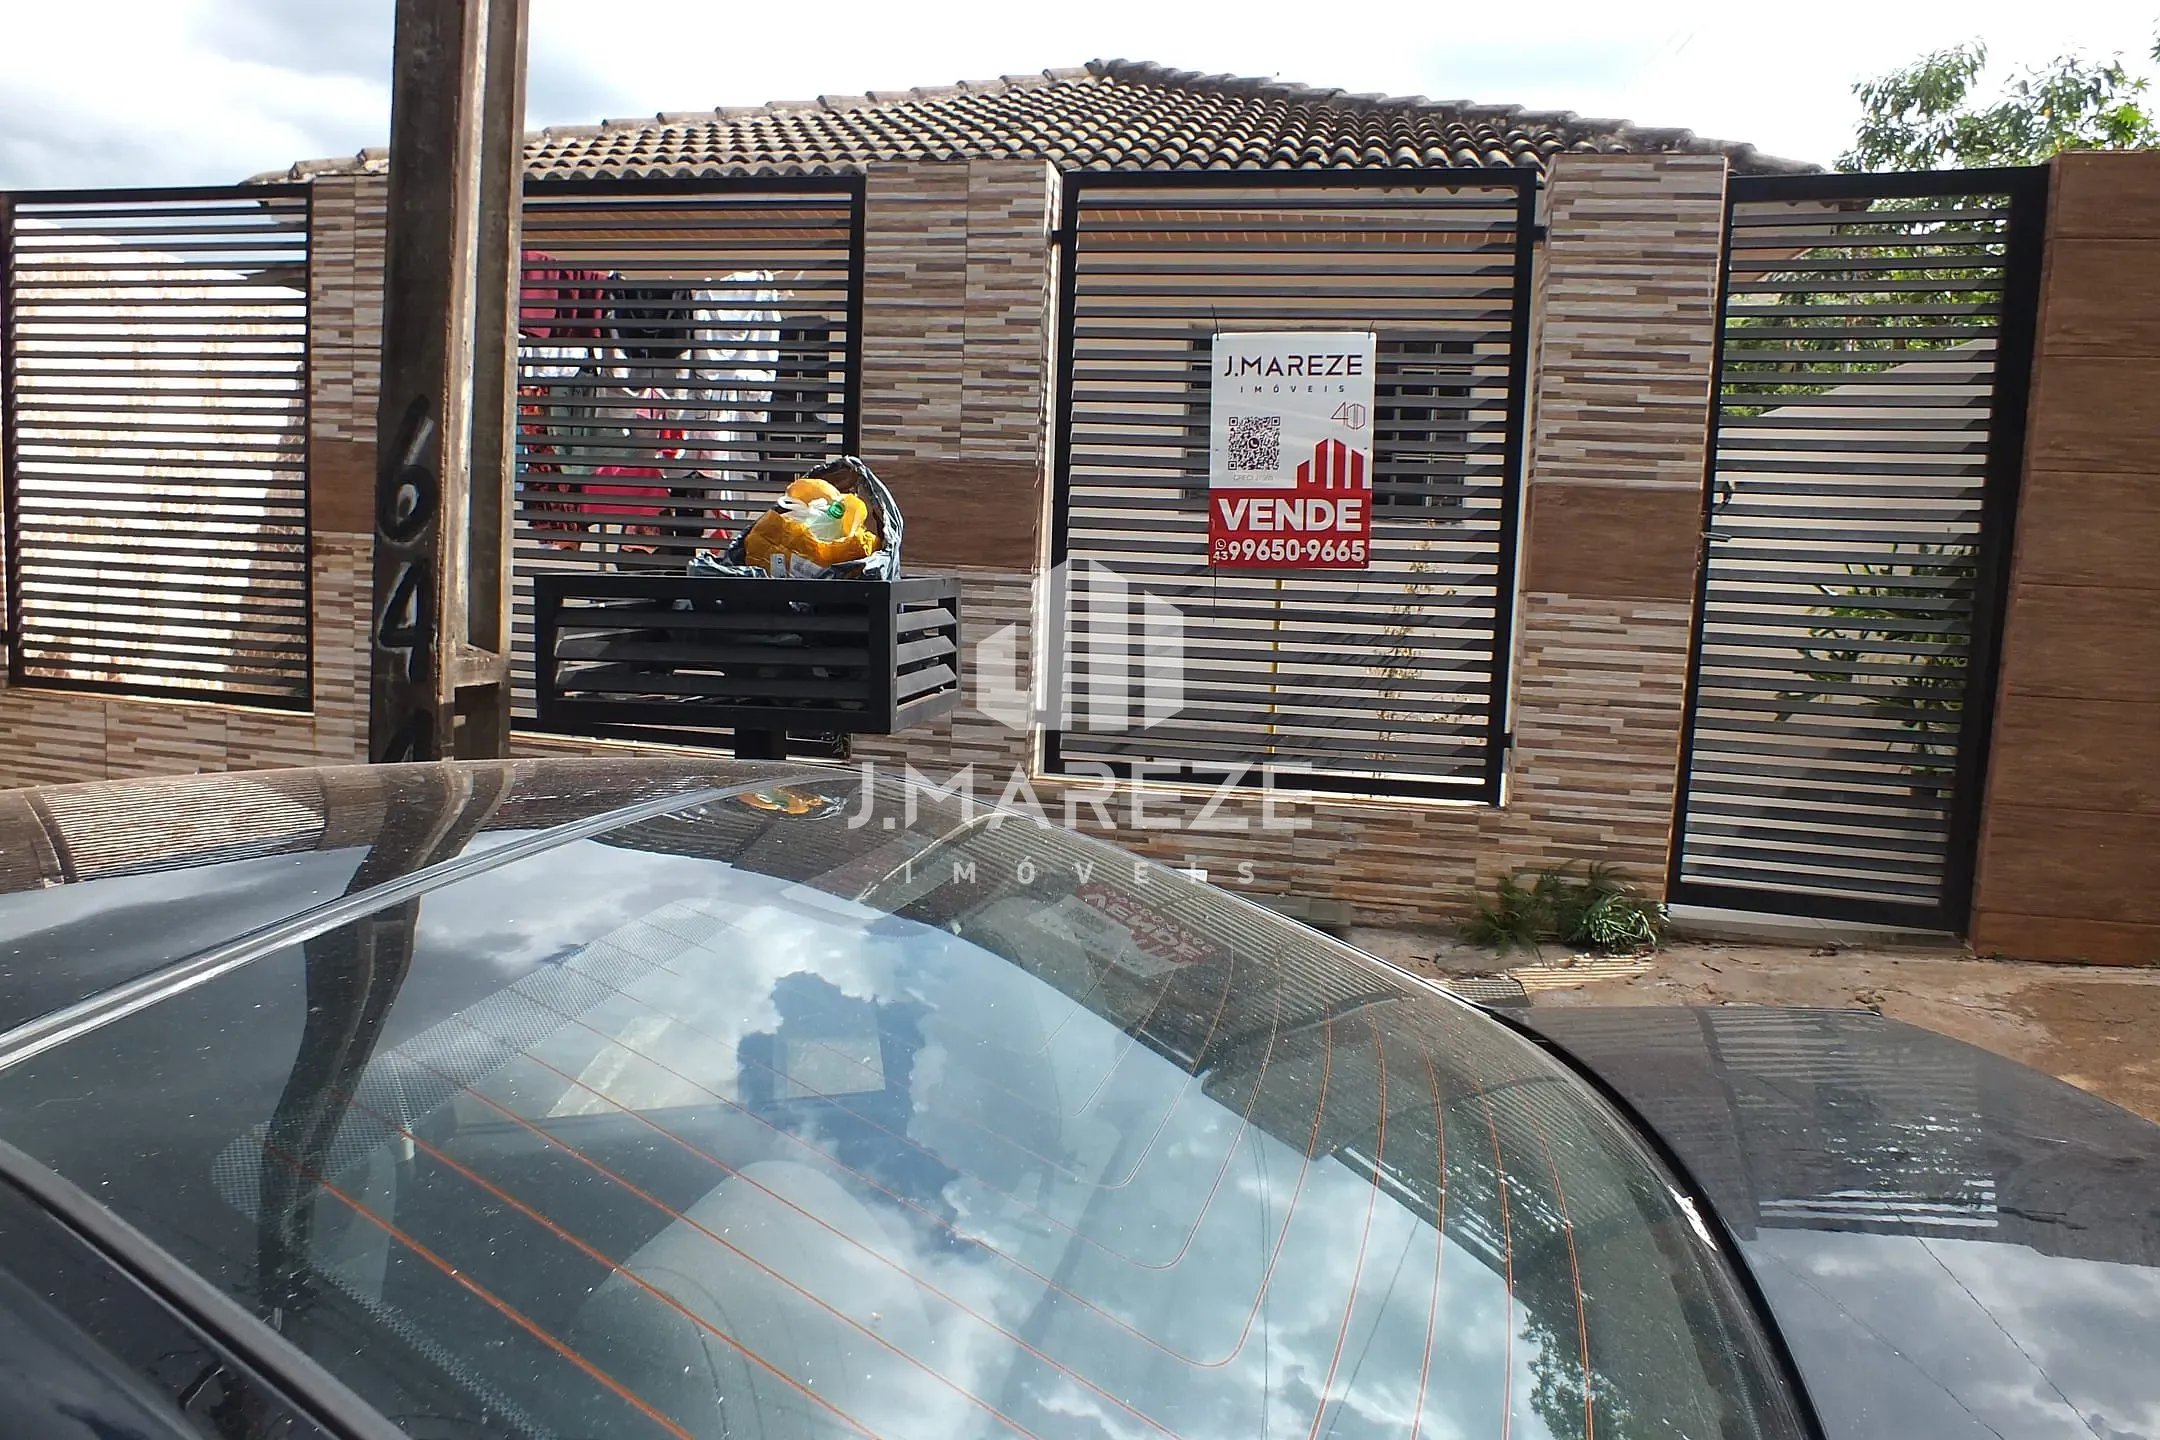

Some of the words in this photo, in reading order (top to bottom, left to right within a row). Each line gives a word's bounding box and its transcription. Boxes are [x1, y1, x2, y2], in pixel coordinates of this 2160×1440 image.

[1224, 355, 1363, 376] J.MAREZE
[1240, 384, 1345, 393] IMÓVEIS
[1218, 498, 1363, 532] VENDE
[1214, 550, 1228, 561] 43
[1229, 538, 1366, 562] 99650-9665
